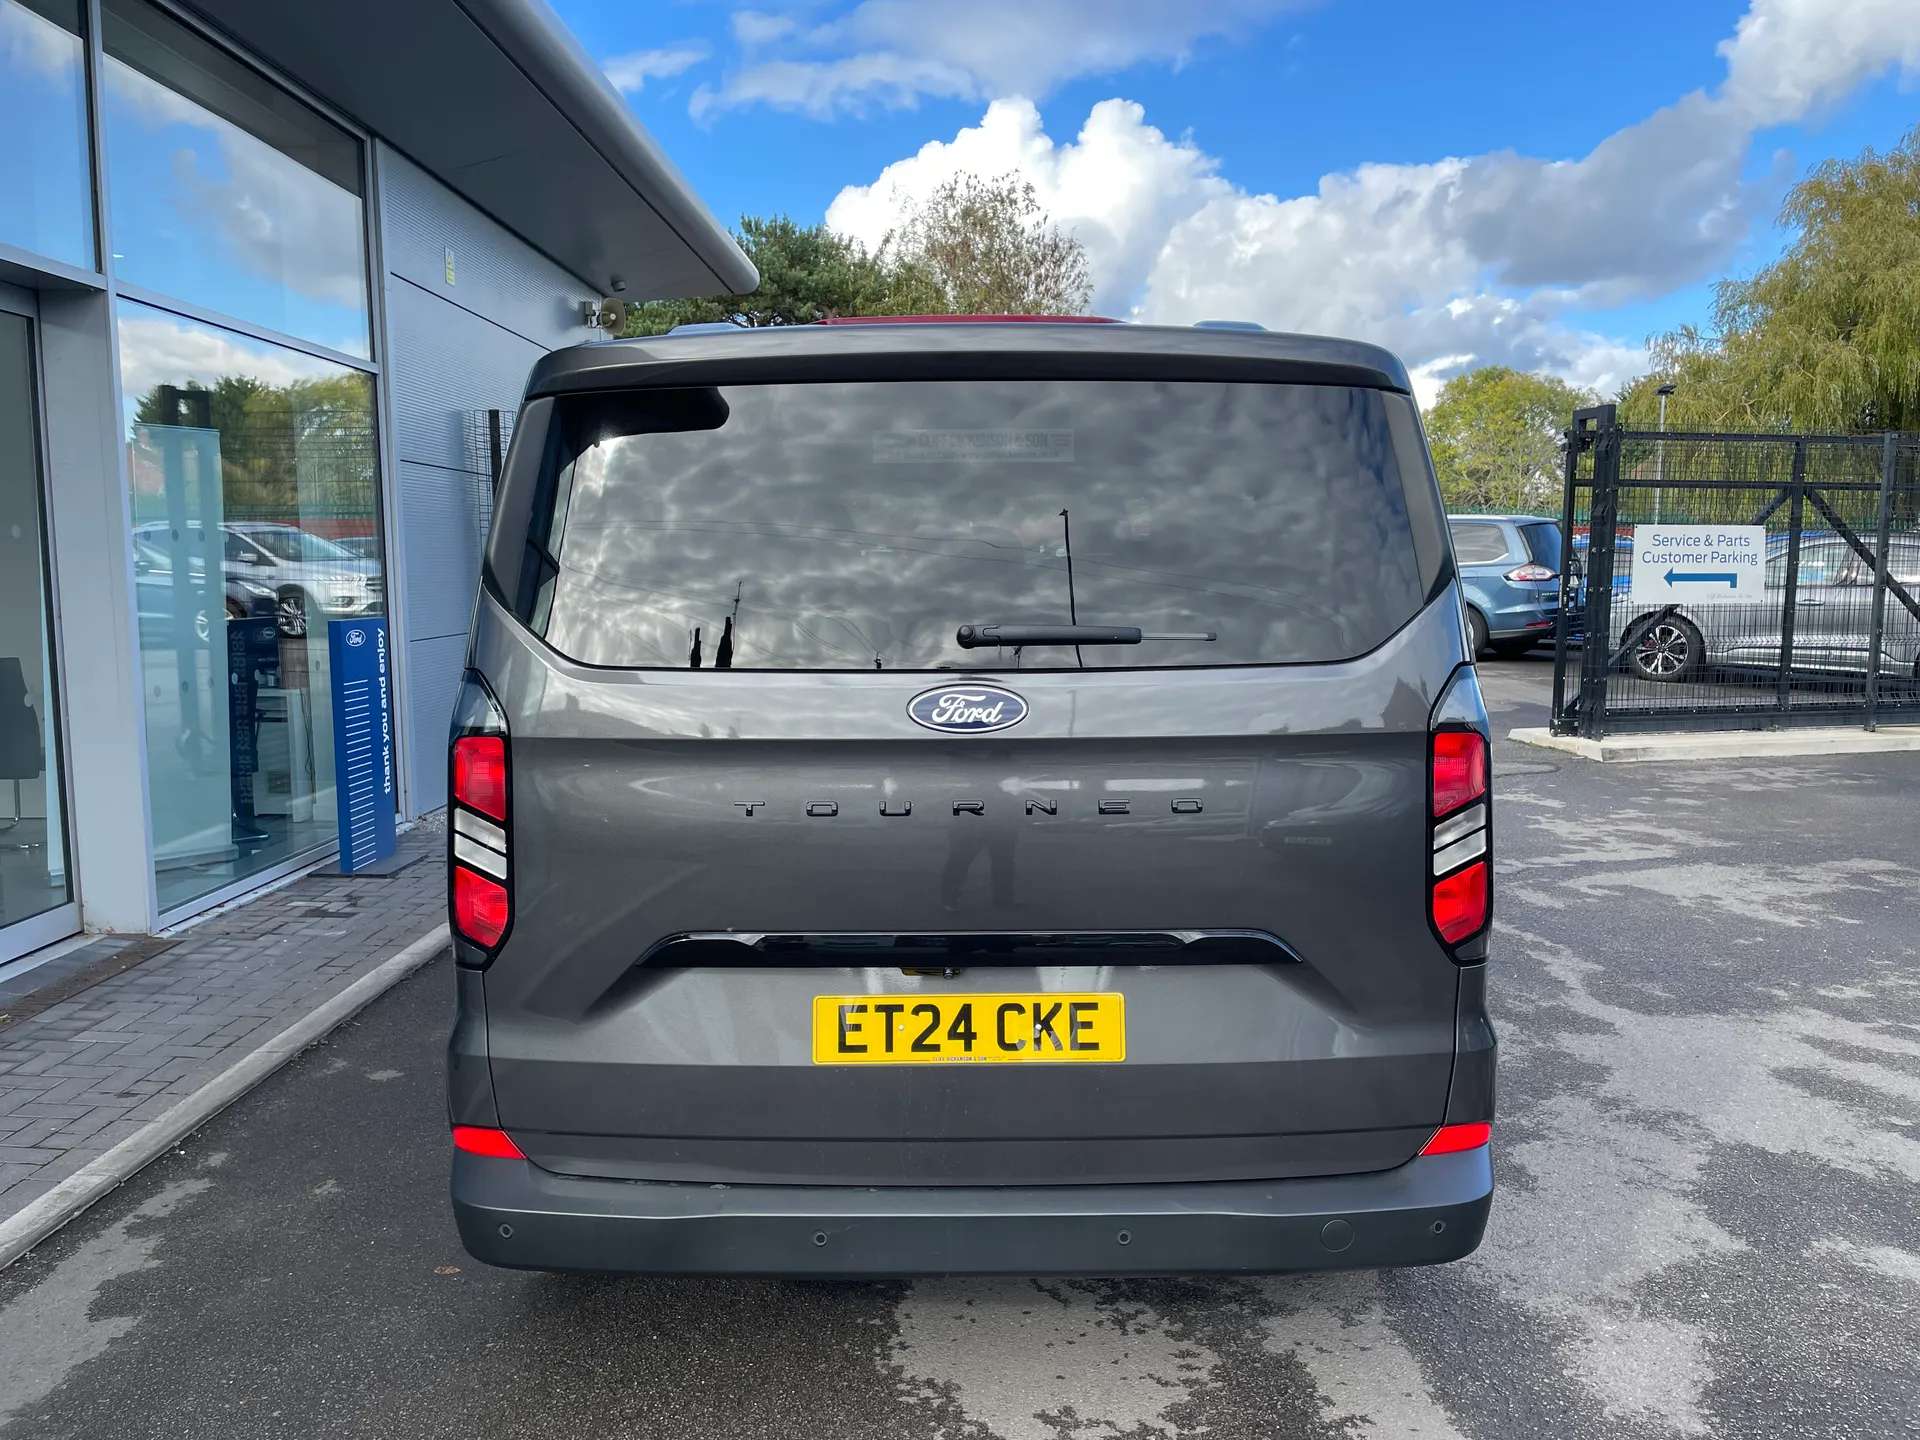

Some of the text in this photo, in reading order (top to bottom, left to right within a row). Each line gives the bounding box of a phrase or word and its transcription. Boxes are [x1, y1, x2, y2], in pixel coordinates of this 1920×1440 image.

[1652, 534, 1750, 547] Service & Parts
[1642, 551, 1758, 565] Customer Parking
[377, 628, 391, 794] thank you and enjoy
[932, 694, 1004, 723] Ford
[733, 798, 1204, 817] TOURNEO
[837, 1002, 1100, 1053] ET24 CKE
